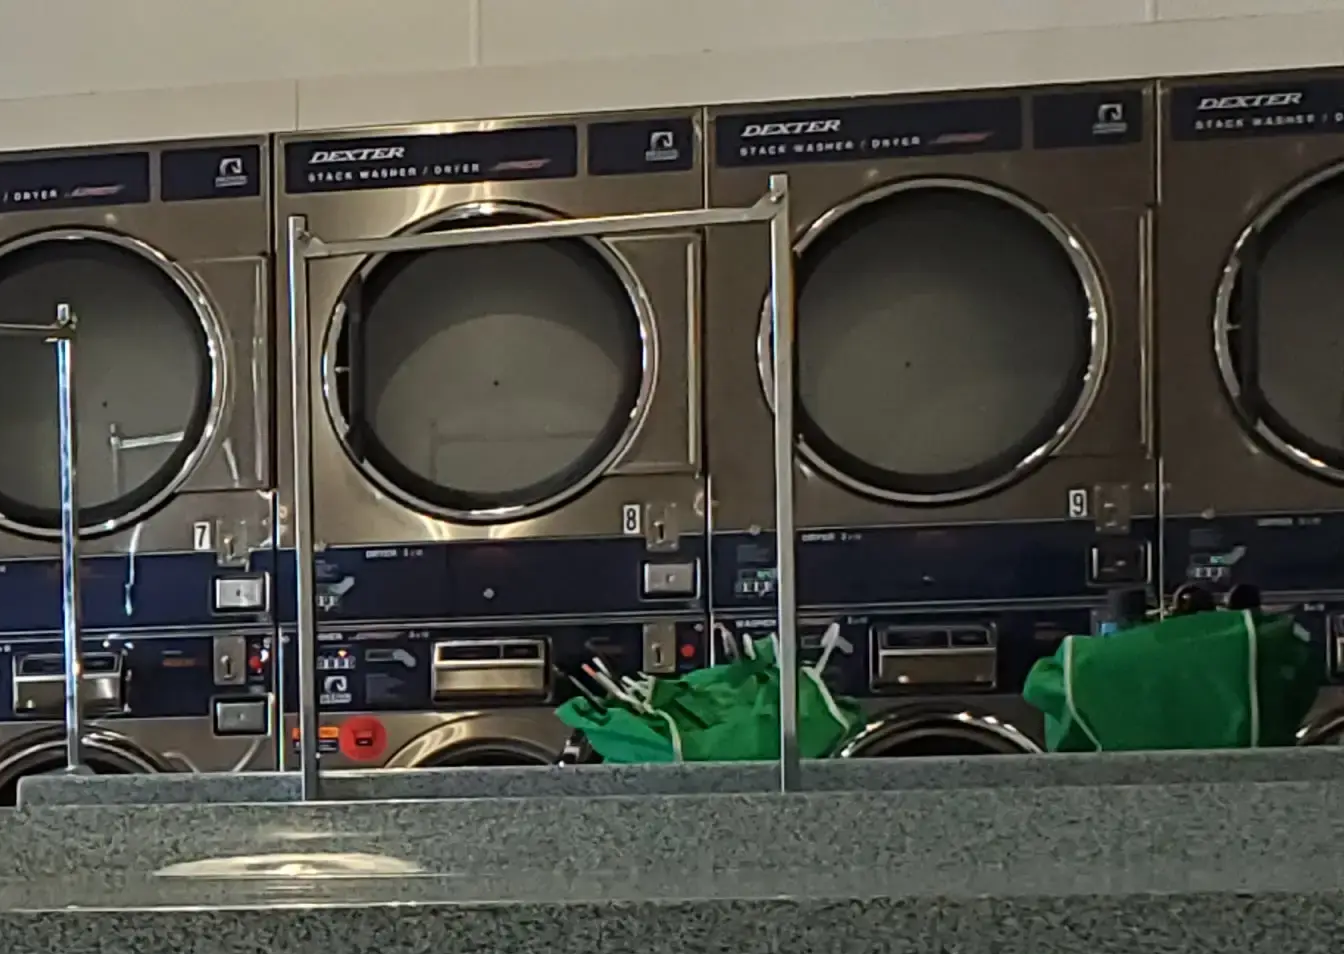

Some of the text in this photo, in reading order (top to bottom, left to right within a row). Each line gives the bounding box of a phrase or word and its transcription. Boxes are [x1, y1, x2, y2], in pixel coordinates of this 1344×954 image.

[1197, 92, 1302, 110] DEXTER
[740, 118, 841, 138] DEXTER
[308, 145, 406, 165] DEXTER
[739, 143, 787, 158] STACK
[793, 140, 854, 154] WASHER
[871, 135, 922, 150] DRYER
[307, 168, 354, 183] STACK
[359, 164, 417, 180] WASHER
[433, 162, 481, 175] DRYER
[14, 188, 58, 202] DRYER
[1073, 493, 1083, 516] 9
[627, 508, 637, 531] 8
[195, 525, 207, 548] 7
